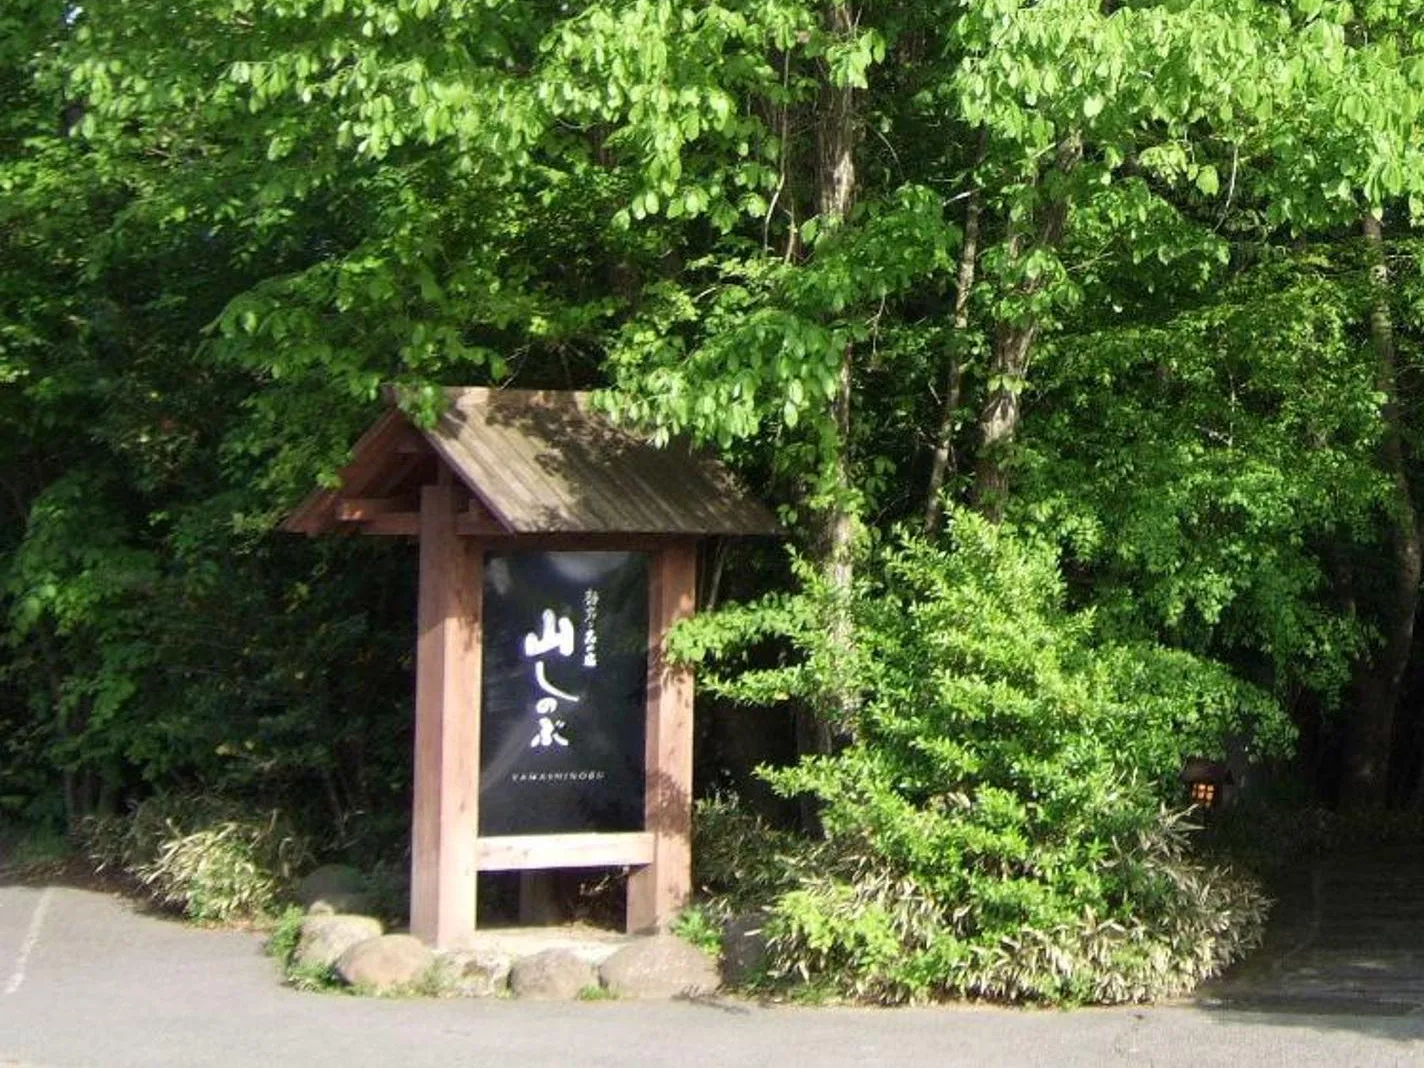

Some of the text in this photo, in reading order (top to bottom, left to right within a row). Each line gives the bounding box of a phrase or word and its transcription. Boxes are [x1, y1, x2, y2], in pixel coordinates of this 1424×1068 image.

[524, 608, 579, 747] 山しのぶ
[511, 770, 605, 781] YAMASHINOBU
